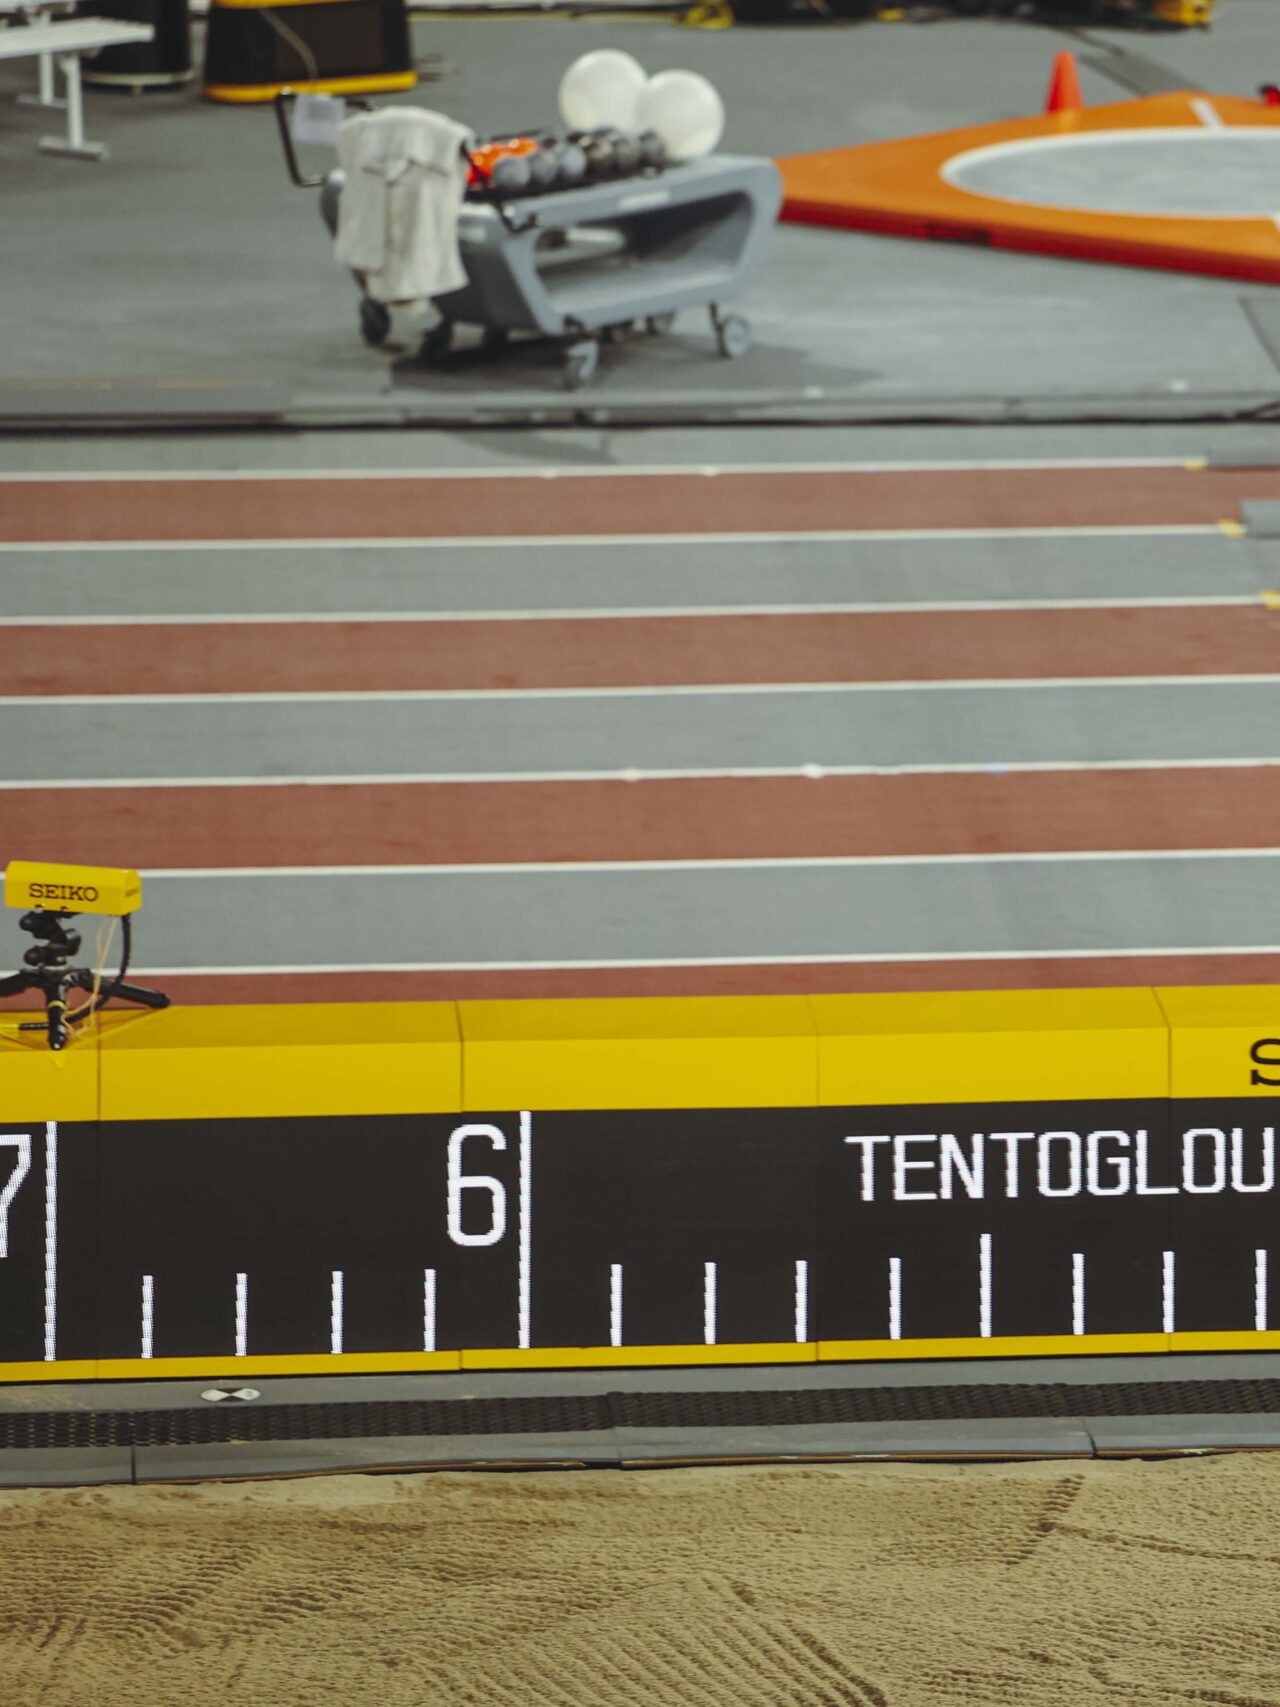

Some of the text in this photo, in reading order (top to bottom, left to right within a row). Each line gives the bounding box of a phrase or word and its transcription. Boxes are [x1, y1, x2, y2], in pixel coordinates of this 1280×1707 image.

[29, 883, 98, 902] SEIKO
[0, 1133, 32, 1258] 7
[446, 1123, 507, 1247] 6
[845, 1127, 1275, 1202] TENTOGLOU
